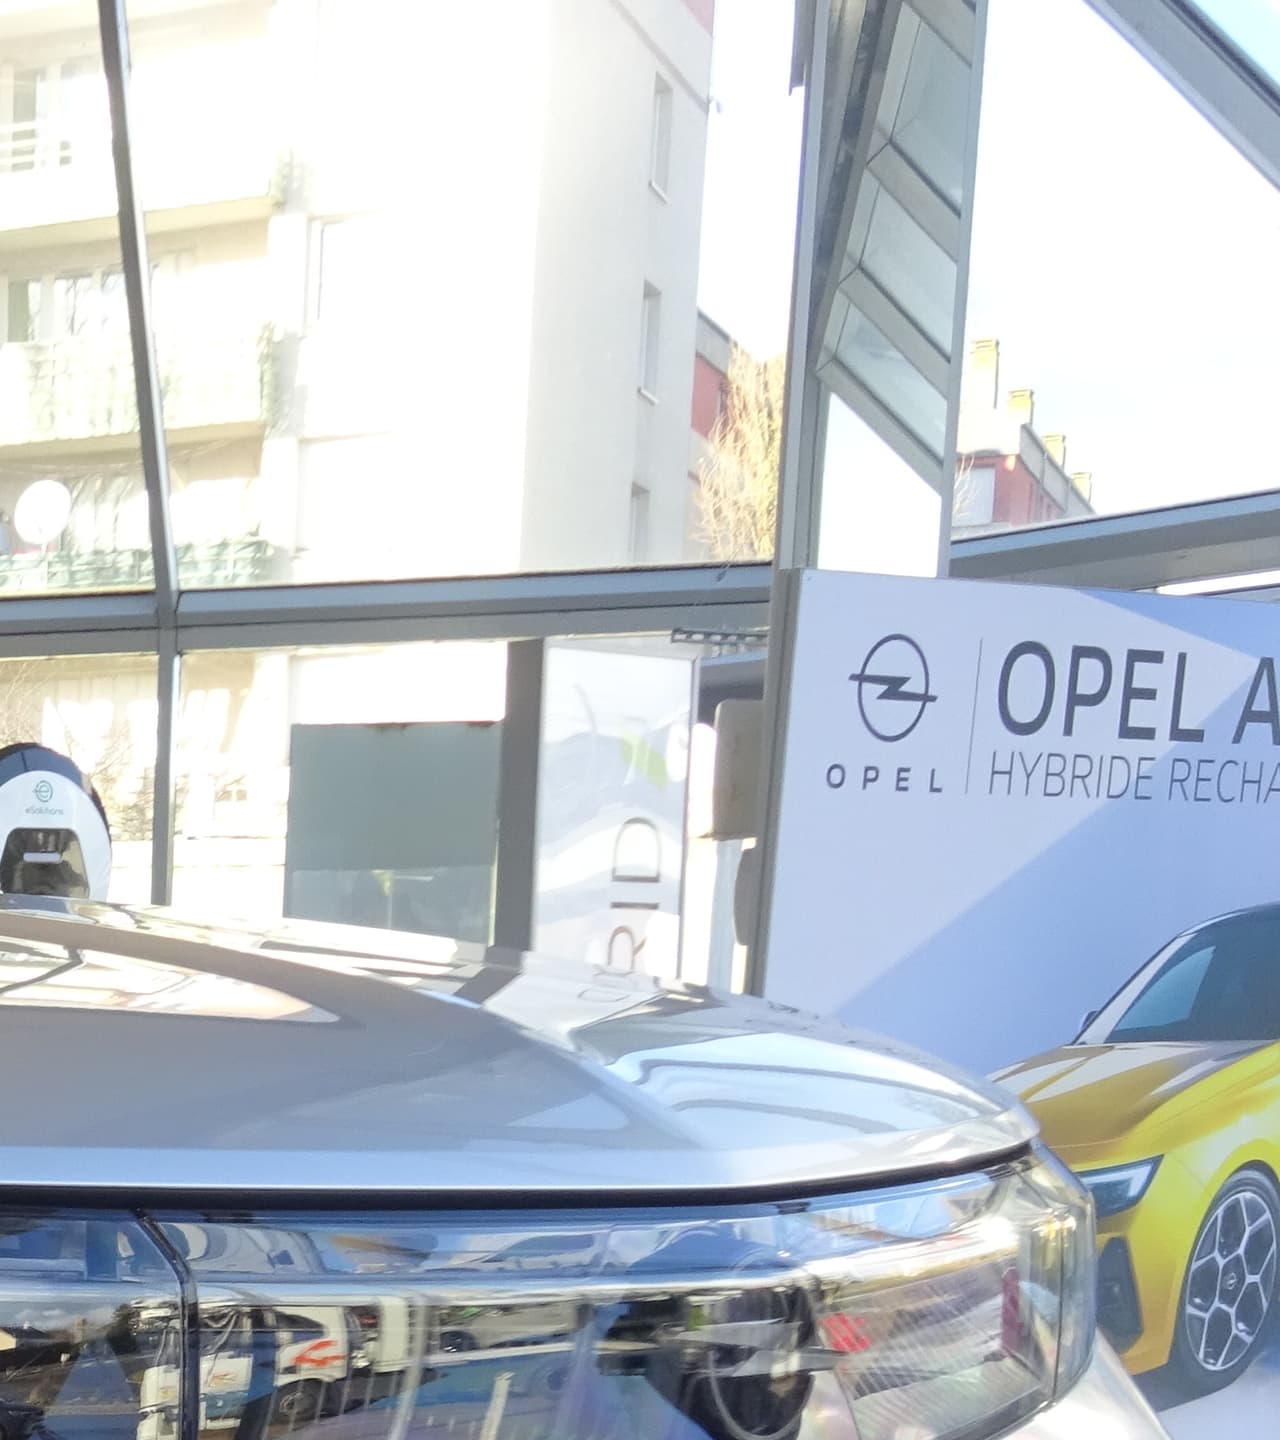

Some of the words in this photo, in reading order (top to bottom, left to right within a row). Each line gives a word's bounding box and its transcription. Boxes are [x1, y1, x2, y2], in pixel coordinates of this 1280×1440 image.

[997, 640, 1205, 743] OPEL
[826, 763, 943, 793] OPEL
[989, 749, 1156, 800] HYBRIDE
